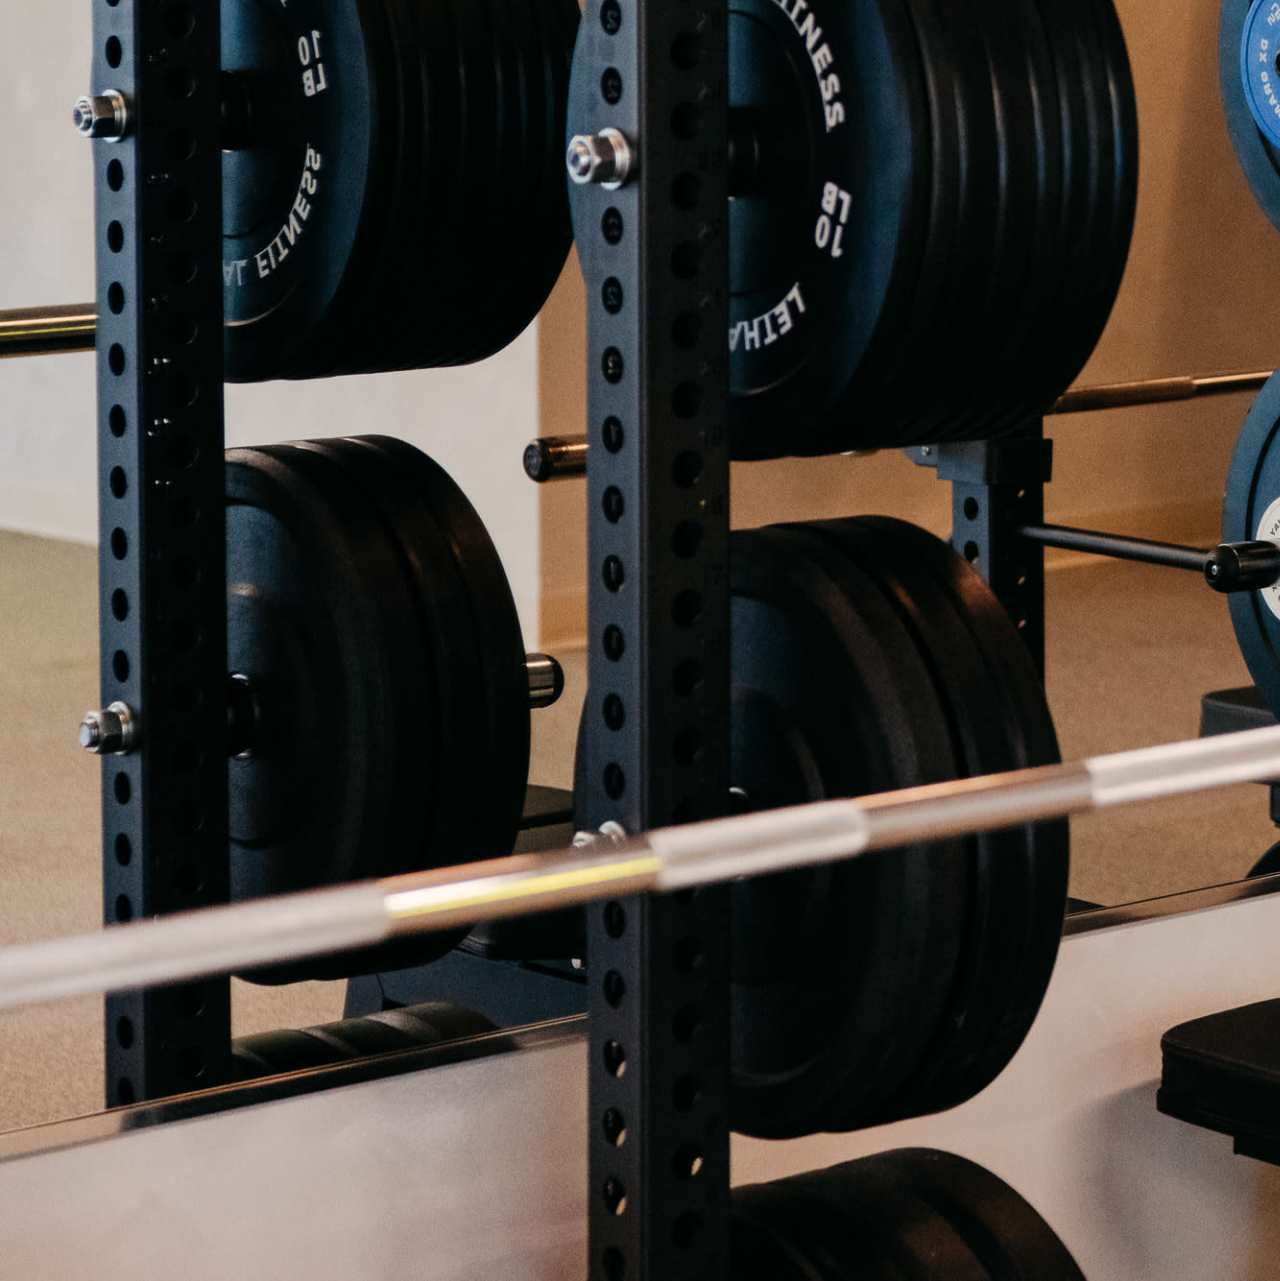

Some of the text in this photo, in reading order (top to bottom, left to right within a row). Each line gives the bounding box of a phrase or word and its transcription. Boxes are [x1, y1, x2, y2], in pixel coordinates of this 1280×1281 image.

[820, 179, 852, 224] LB
[814, 213, 845, 260] 10
[727, 281, 807, 354] LETHA
